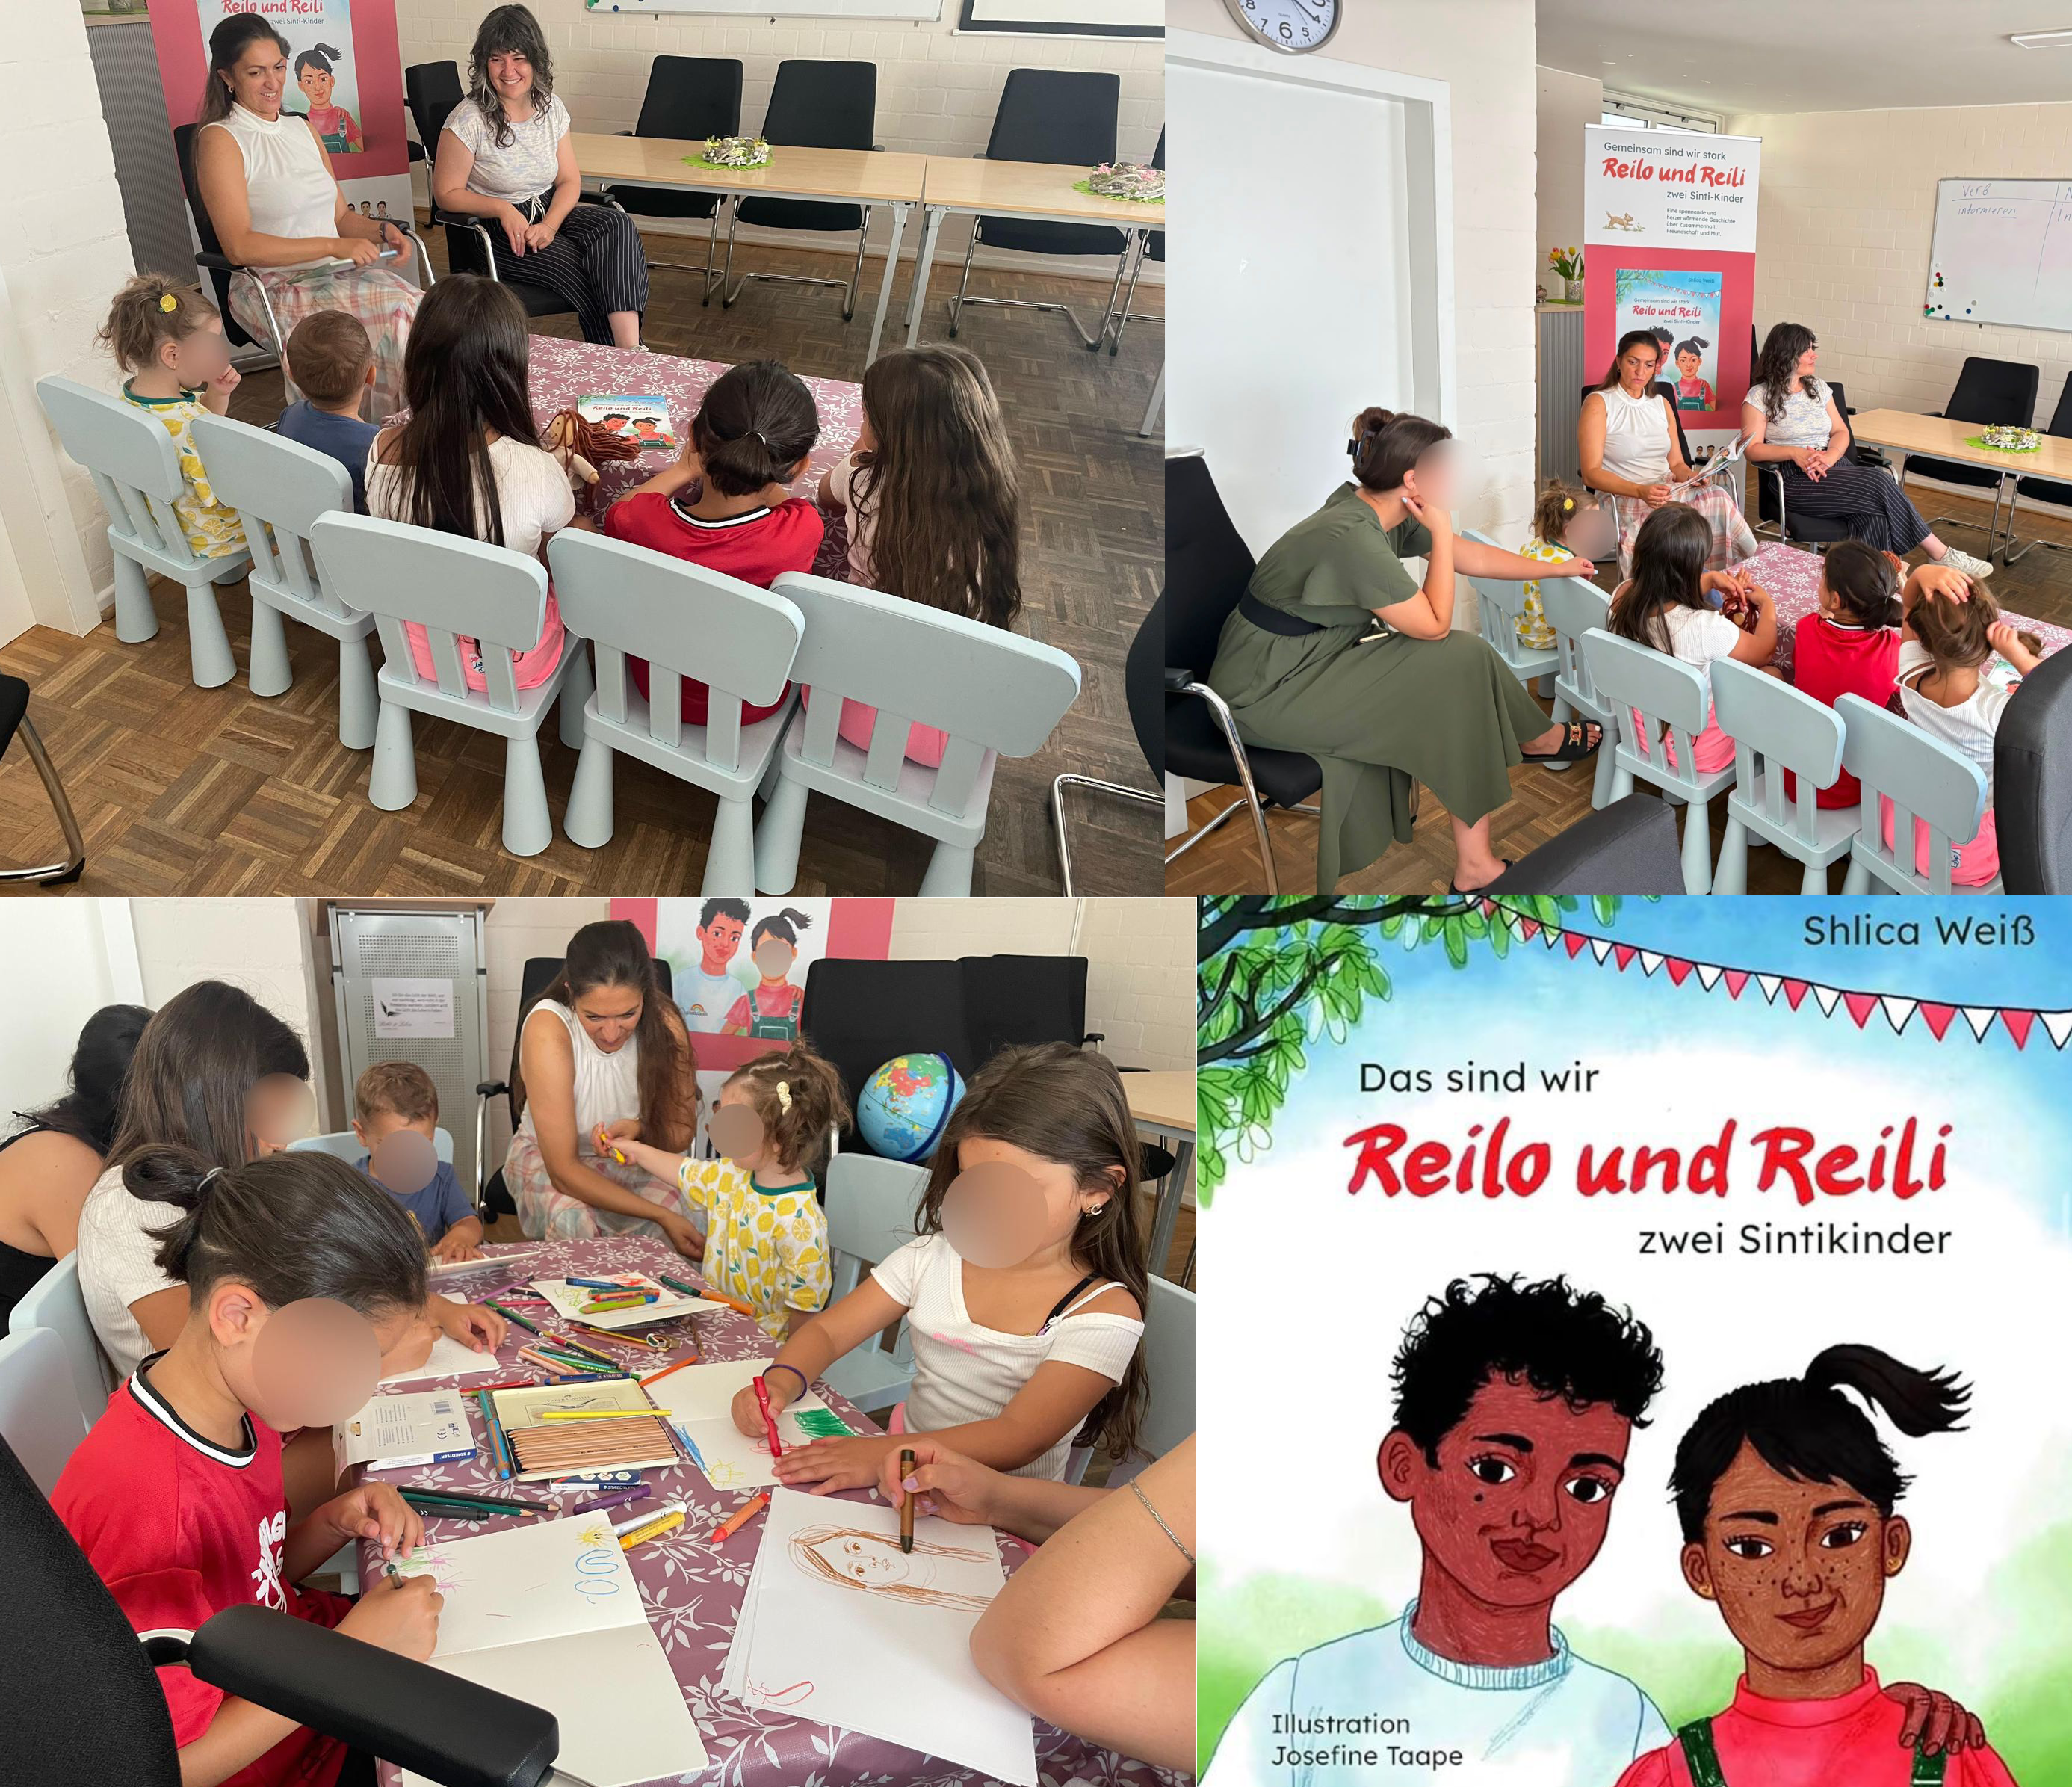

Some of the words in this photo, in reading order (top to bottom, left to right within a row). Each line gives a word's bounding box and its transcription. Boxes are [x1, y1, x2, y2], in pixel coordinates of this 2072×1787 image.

[261, 0, 287, 13] und
[1261, 18, 1269, 28] 7
[1279, 21, 1293, 40] 6
[1302, 27, 1310, 37] 5
[1604, 142, 1662, 155] Gemeinsam
[1664, 147, 1683, 157] sind
[1686, 149, 1701, 158] wir
[1703, 151, 1727, 161] stark
[1602, 158, 1654, 180] Reilo
[1658, 163, 1697, 184] und
[1700, 166, 1746, 187] Reili
[1666, 191, 1687, 200] zwei
[1690, 191, 1744, 203] Sinti-Kinder
[1958, 203, 2016, 215] informieren
[1632, 304, 1656, 315] Reilo
[1658, 306, 1677, 317] und
[1678, 306, 1702, 318] Reili
[1803, 913, 1920, 946] Shlica
[1935, 913, 2035, 946] Weiß
[1360, 1063, 1432, 1093] Das
[1447, 1060, 1526, 1093] sind
[1540, 1060, 1600, 1093] wir
[1343, 1116, 1551, 1198] Reilo
[1577, 1118, 1737, 1198] und
[1750, 1116, 1953, 1206] Reili
[1639, 1221, 1723, 1254] zwei
[1739, 1221, 1952, 1254] Sintikinder
[1272, 1712, 1410, 1734] Illustration
[1272, 1744, 1378, 1765] Josefine
[1387, 1746, 1463, 1771] Taape
